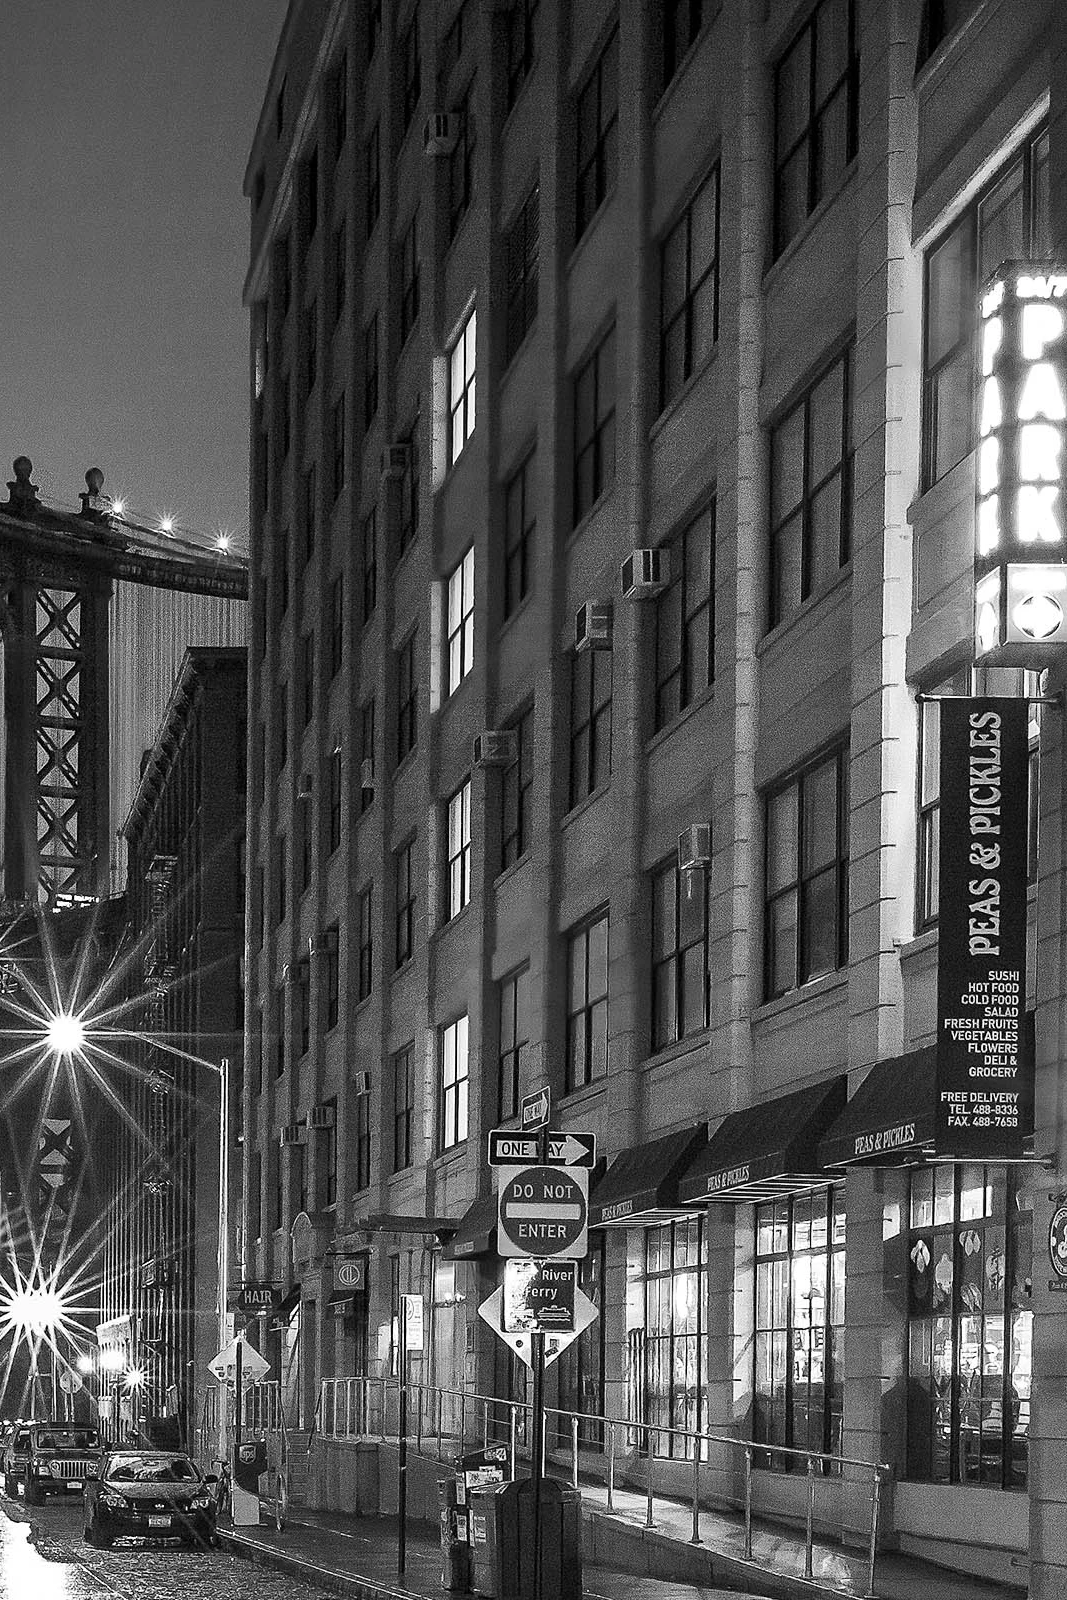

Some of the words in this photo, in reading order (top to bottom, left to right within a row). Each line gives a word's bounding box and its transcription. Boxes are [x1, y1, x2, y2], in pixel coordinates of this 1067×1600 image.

[1018, 304, 1066, 543] PARK
[968, 711, 1002, 835] PICKLES
[968, 842, 1001, 870] &
[968, 878, 1001, 956] PEAS
[988, 971, 1020, 981] SUSHI
[968, 982, 989, 993] HOT
[991, 982, 1019, 993] FOOD
[961, 994, 989, 1005] COLD
[991, 994, 1019, 1005] FOOD
[984, 1006, 1019, 1017] SALAD
[944, 1018, 980, 1029] FRESH
[982, 1018, 1019, 1030] FRUITS
[951, 1030, 1019, 1042] VEGETABLES
[968, 1042, 1018, 1053] FLOWERS
[984, 1055, 1007, 1066] DELI
[1009, 1055, 1018, 1066] &
[968, 1066, 1018, 1077] GROCERY
[940, 1091, 968, 1102] FREE
[970, 1092, 1019, 1103] DELIVERY
[949, 1104, 971, 1115] TEL.
[972, 1104, 1018, 1115] 488-8336
[948, 1116, 971, 1127] FAX.
[972, 1116, 1018, 1127] 488-7658
[854, 1134, 874, 1154] PEAS
[874, 1132, 883, 1150] &
[883, 1123, 915, 1149] PICKLES
[501, 1142, 530, 1156] ONE
[536, 1142, 564, 1157] AY
[513, 1184, 534, 1198] DO
[543, 1185, 574, 1199] NOT
[518, 1224, 567, 1238] ENTER
[542, 1269, 573, 1281] River
[244, 1290, 272, 1304] HAIR
[525, 1287, 558, 1300] Ferry
